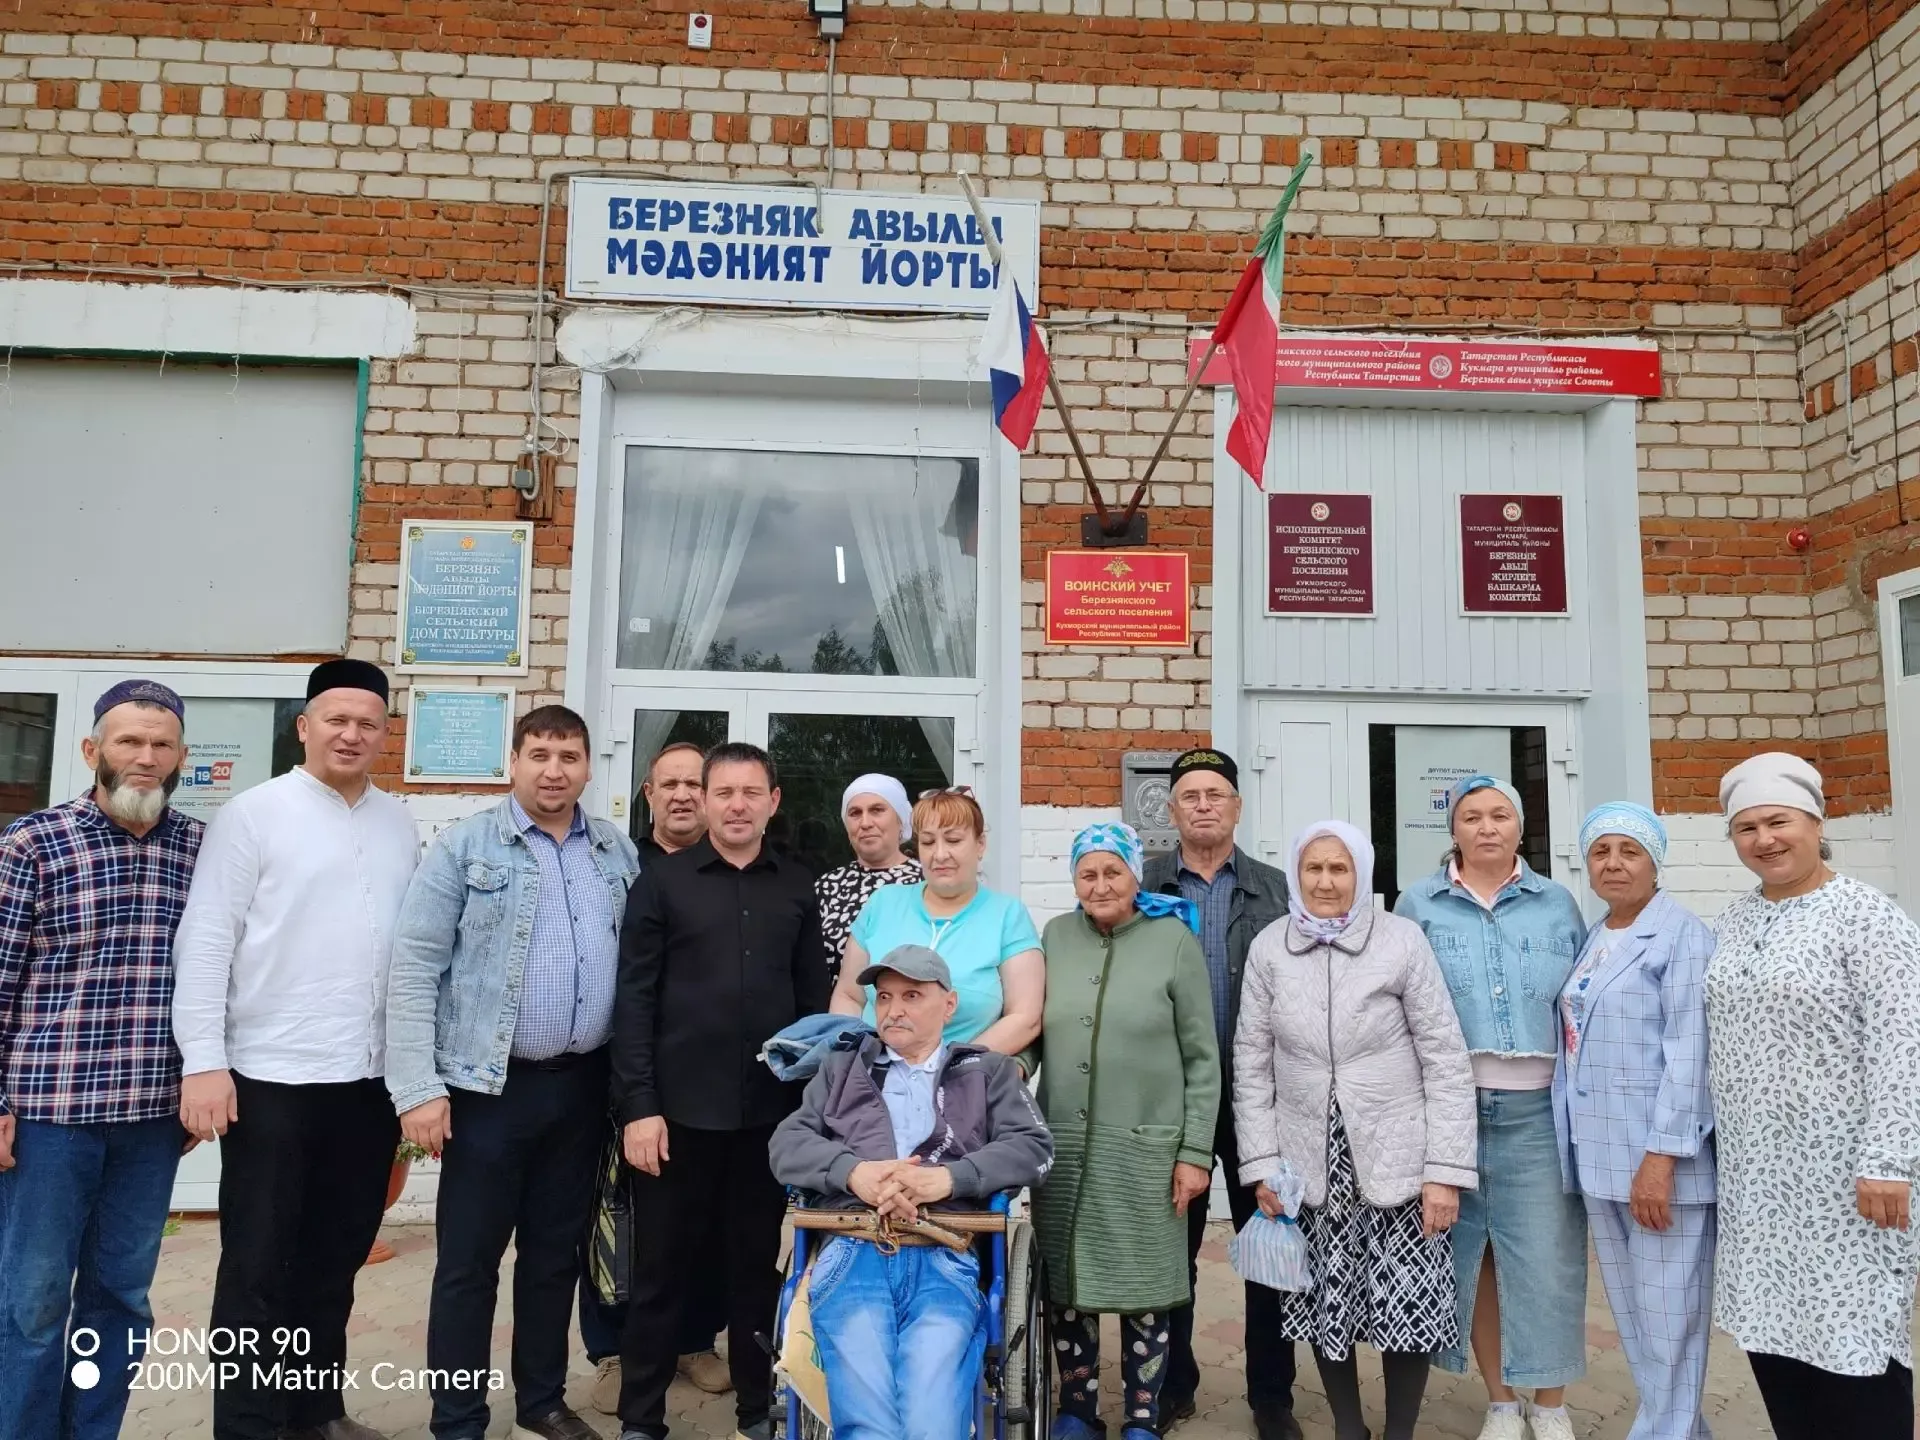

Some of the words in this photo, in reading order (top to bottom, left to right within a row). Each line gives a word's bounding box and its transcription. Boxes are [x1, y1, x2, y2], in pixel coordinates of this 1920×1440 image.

[608, 197, 819, 239] БЕРЕЗНЯК
[848, 208, 1003, 246] АВЫЛЫ
[607, 238, 831, 284] МӘДӘНИЯТ
[861, 243, 1000, 290] ЙОРТЫ
[1324, 350, 1369, 358] сельского
[1372, 350, 1421, 359] поселения
[1460, 350, 1518, 362] Татарстан
[1520, 352, 1587, 364] Республикасы
[1302, 359, 1383, 370] муниципального
[1385, 361, 1421, 371] района
[1459, 363, 1504, 374] Кукмара
[1506, 365, 1564, 375] муниципаль
[1565, 366, 1604, 376] районы
[1304, 369, 1361, 382] Республики
[1362, 371, 1421, 382] Татарстан
[1459, 374, 1505, 385] Березняк
[1507, 376, 1532, 385] авыл
[1574, 377, 1614, 387] Советы
[1275, 525, 1367, 535] ИСПОЛНИТЕЛЬНЫЙ
[1299, 536, 1343, 544] КОМИТЕТ
[1283, 546, 1360, 555] БЕРЕЗНЯКСКОГО
[1295, 556, 1348, 565] СЕЛЬСКОГО
[435, 564, 501, 575] БЕРЕЗНЯК
[1292, 566, 1349, 575] ПОСЕЛЕНИЯ
[1499, 562, 1528, 571] АВЫЛ
[478, 583, 518, 597] ЙОРТЫ
[1064, 579, 1136, 592] ВОИНСКИЙ
[1139, 581, 1172, 593] УЧЕТ
[1487, 583, 1542, 592] БАШКАРМА
[1081, 595, 1156, 606] Березнякского
[1489, 593, 1542, 602] КОМИТЕТЫ
[415, 605, 509, 617] БЕРЕЗНЯКСКИЙ
[1063, 608, 1116, 616] сельского
[1118, 608, 1173, 617] поселения
[426, 616, 499, 627] СЕЛЬСКИЙ
[1055, 622, 1099, 631] Кукморский
[1159, 623, 1181, 631] район
[410, 627, 440, 641] ДОМ
[443, 628, 516, 641] КУЛЬТУРЫ
[1122, 631, 1158, 639] Татарстан
[195, 771, 210, 782] 19
[213, 766, 230, 777] 20
[181, 776, 193, 787] 18
[1432, 800, 1445, 810] 18
